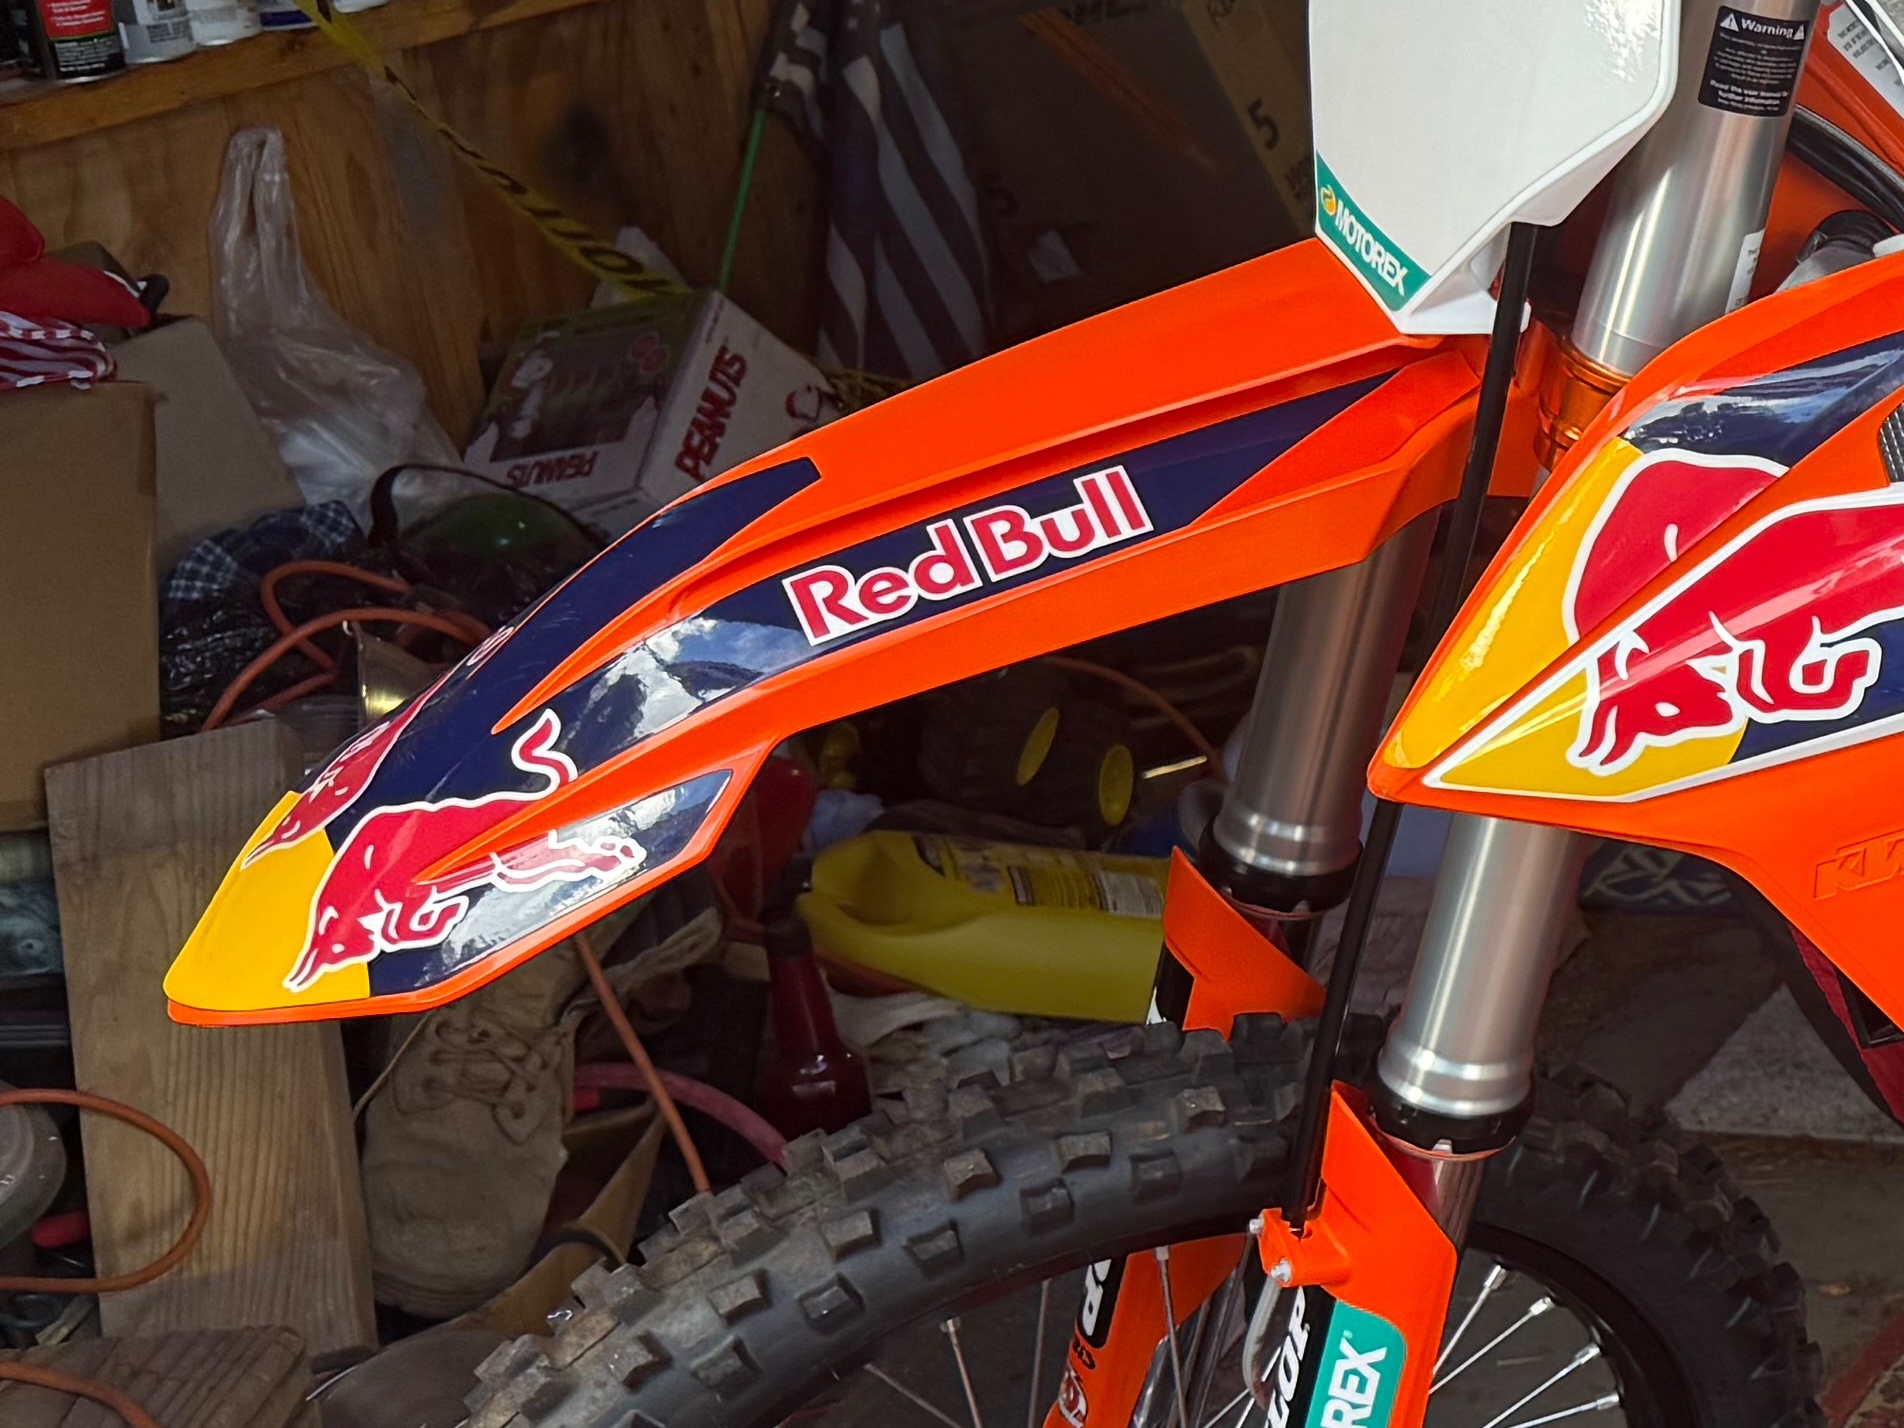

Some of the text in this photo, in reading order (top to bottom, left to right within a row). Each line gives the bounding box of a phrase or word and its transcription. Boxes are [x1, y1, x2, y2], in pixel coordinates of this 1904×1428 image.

[1741, 17, 1795, 39] Warning
[1334, 198, 1409, 297] MOTOREX
[675, 343, 748, 482] PEANUTS
[785, 467, 1150, 643] Red Bull
